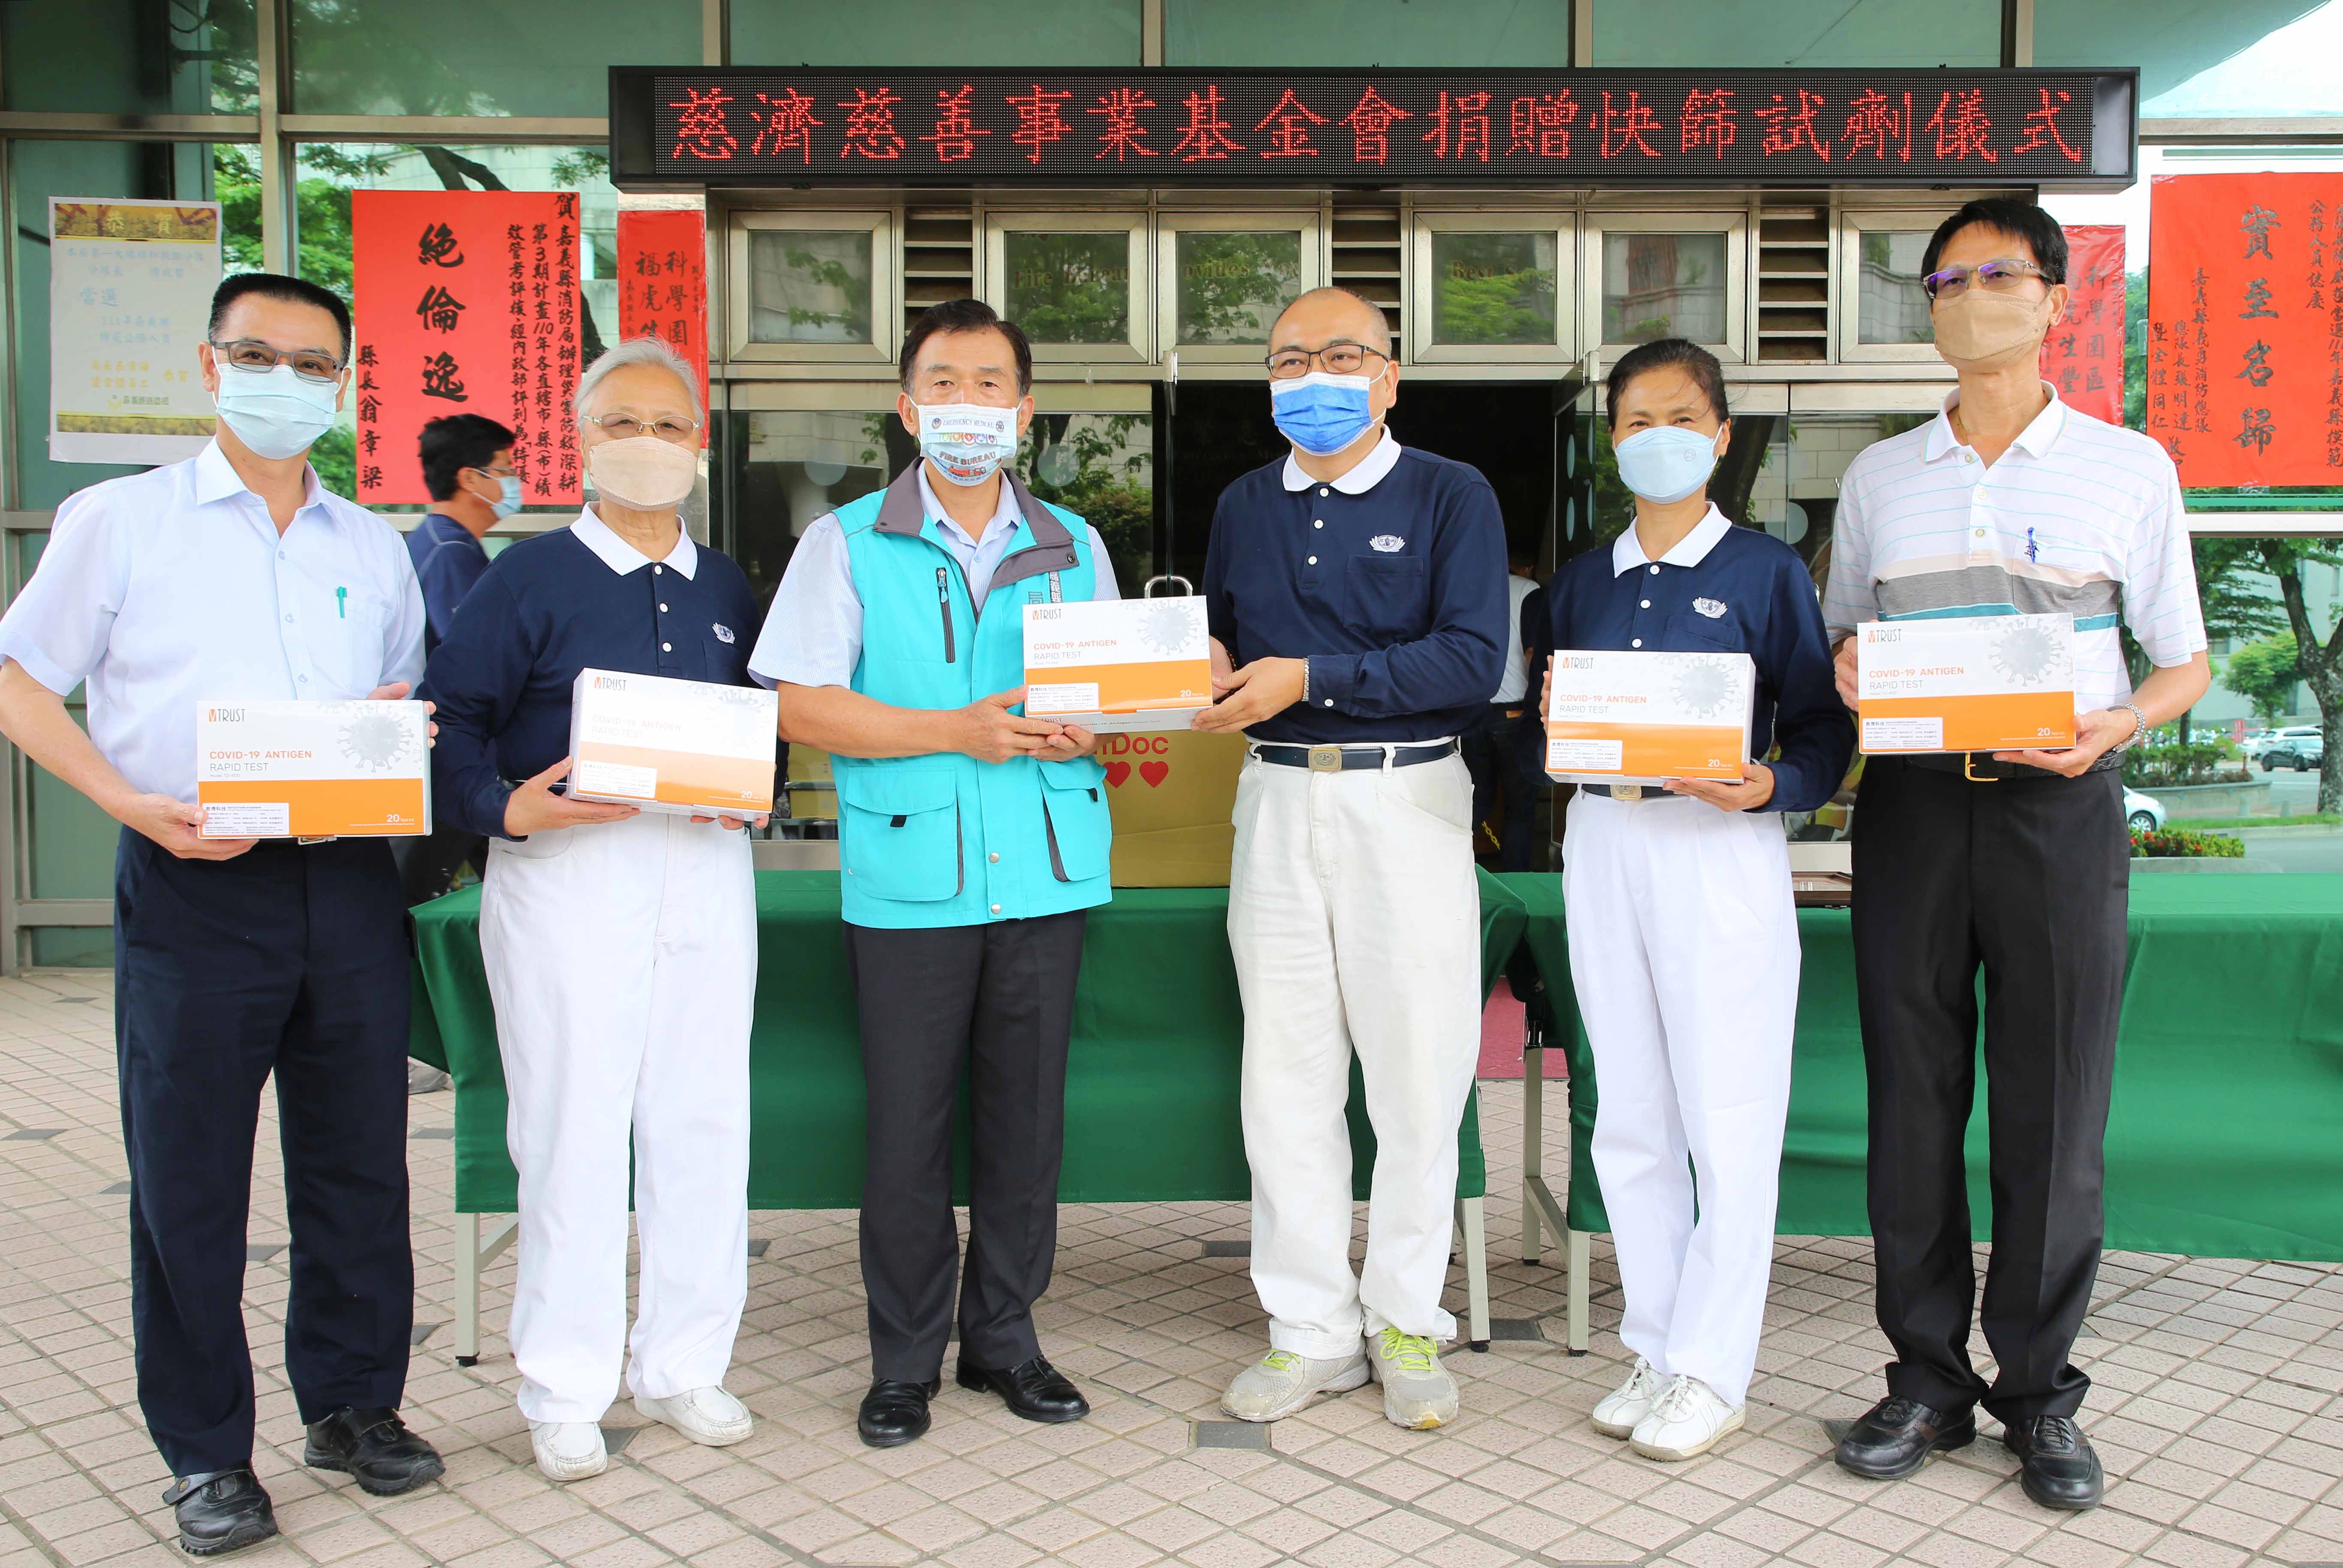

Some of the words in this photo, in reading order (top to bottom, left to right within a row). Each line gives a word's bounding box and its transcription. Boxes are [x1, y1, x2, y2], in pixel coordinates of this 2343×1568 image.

[668, 83, 2083, 166] 慈濟慈善事業基金會捐贈快篩試劑儀式
[555, 193, 576, 220] 賀
[106, 210, 172, 234] 恭賀
[79, 288, 118, 307] 當選
[416, 223, 468, 403] 絕倫逸
[2232, 205, 2281, 457] 實至名歸
[357, 345, 383, 489] 縣長翁章梁
[939, 451, 959, 464] FIRE
[961, 451, 996, 465] BUREAU
[1034, 641, 1074, 651] COVID-19
[1078, 639, 1117, 648] ANTIGEN
[1061, 651, 1081, 659] TEST
[1869, 669, 1915, 678] COVID-19
[1920, 666, 1964, 675] ANTIGEN
[1870, 680, 1898, 690] RAPID
[1900, 679, 1923, 688] TEST
[1560, 694, 1603, 703] COVID-19
[1606, 695, 1646, 704] ANTIGEN
[1560, 705, 1586, 713] RAPID
[1587, 706, 1609, 714] TEST
[2038, 727, 2051, 736] 20
[210, 751, 260, 759] COVID-19
[265, 750, 312, 758] ANTIGEN
[210, 763, 241, 771] RAPID
[244, 762, 268, 771] TEST
[1708, 759, 1719, 767] 20
[741, 790, 752, 799] 20
[387, 814, 400, 822] 20
